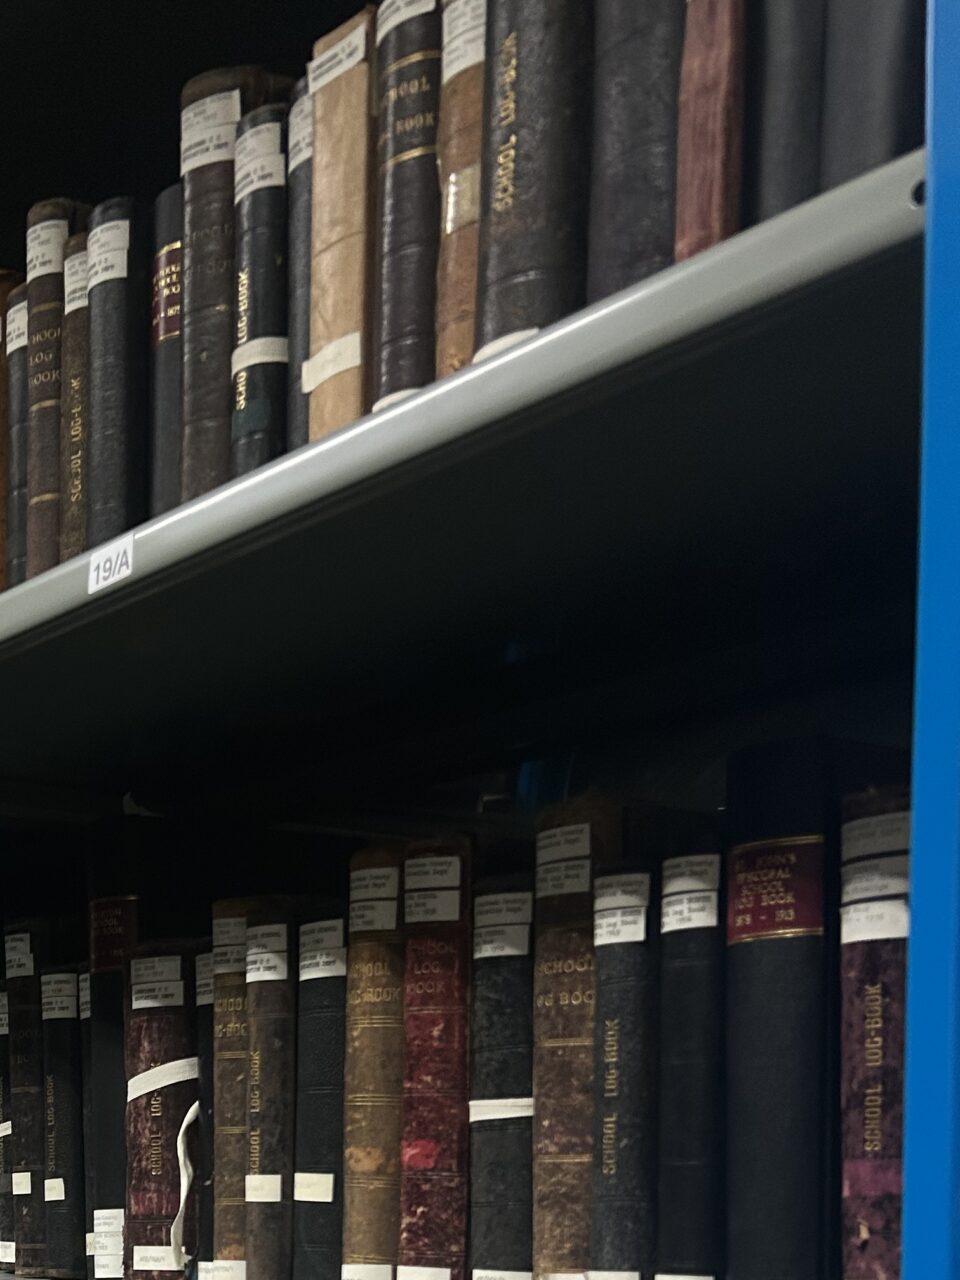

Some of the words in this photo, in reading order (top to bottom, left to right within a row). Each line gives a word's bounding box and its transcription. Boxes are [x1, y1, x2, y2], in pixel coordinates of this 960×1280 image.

[493, 133, 517, 212] SCHOOL
[237, 268, 250, 345] LOG-BOOK
[236, 370, 248, 411] SCHO
[93, 551, 131, 588] 19/A
[414, 960, 442, 975] LOG
[559, 990, 596, 1007] BOO
[865, 982, 883, 1068] LOG-BOOK
[249, 1050, 261, 1113] LOG-BOOK
[603, 1017, 621, 1099] LOG-BOOK
[602, 1112, 617, 1175] SCHOOL
[865, 1084, 883, 1153] SCHOOL
[151, 1131, 162, 1176] SCHOOL
